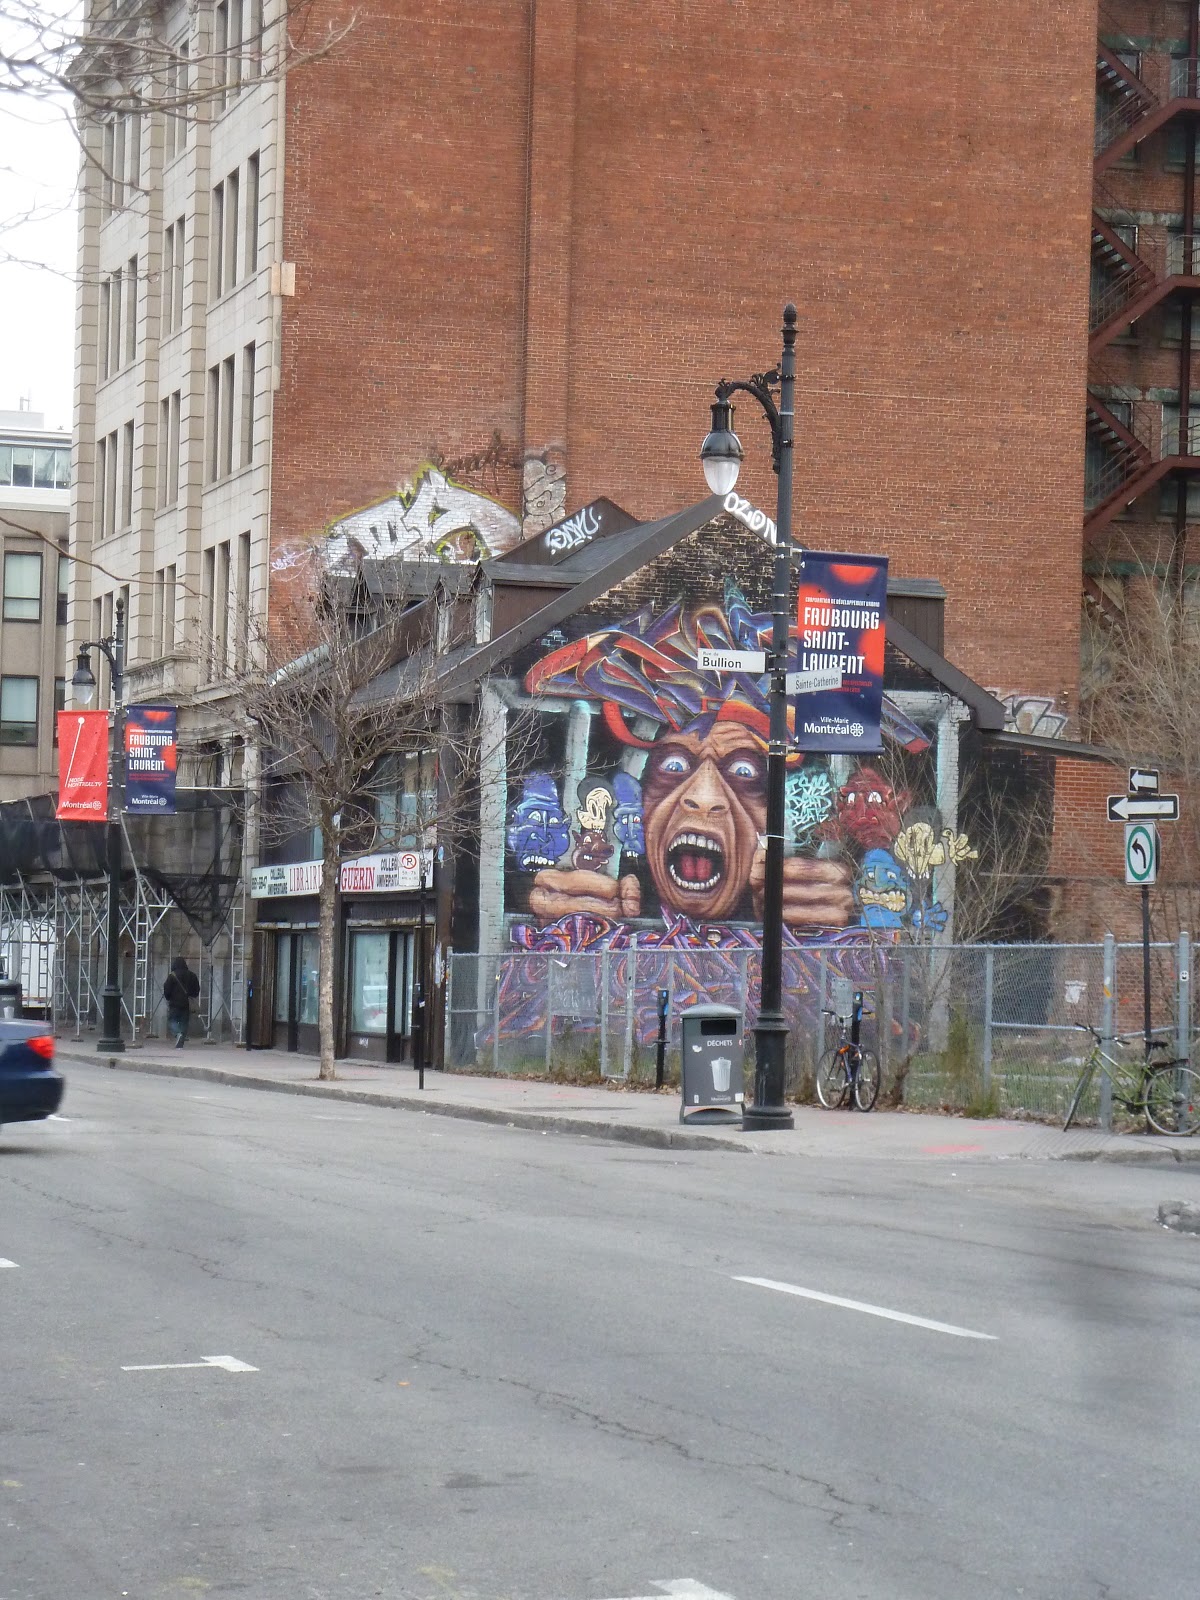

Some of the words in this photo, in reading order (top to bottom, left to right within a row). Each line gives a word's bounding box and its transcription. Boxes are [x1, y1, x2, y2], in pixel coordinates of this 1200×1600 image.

[804, 606, 880, 630] FAUBOURG
[803, 629, 850, 651] SAINT-
[702, 656, 742, 668] Bullion
[802, 652, 865, 675] LAURENT
[796, 676, 839, 690] Sainte-Catherine
[820, 716, 849, 724] Ville-Marie
[804, 722, 850, 735] Montréal
[129, 734, 173, 746] FAUBOURG
[129, 747, 156, 758] SAINT-
[129, 759, 165, 771] LAURENT
[62, 801, 92, 809] Montréal
[131, 797, 159, 805] Montréal
[289, 864, 324, 892] LIBRAIRI
[341, 861, 376, 891] GUÉRIN
